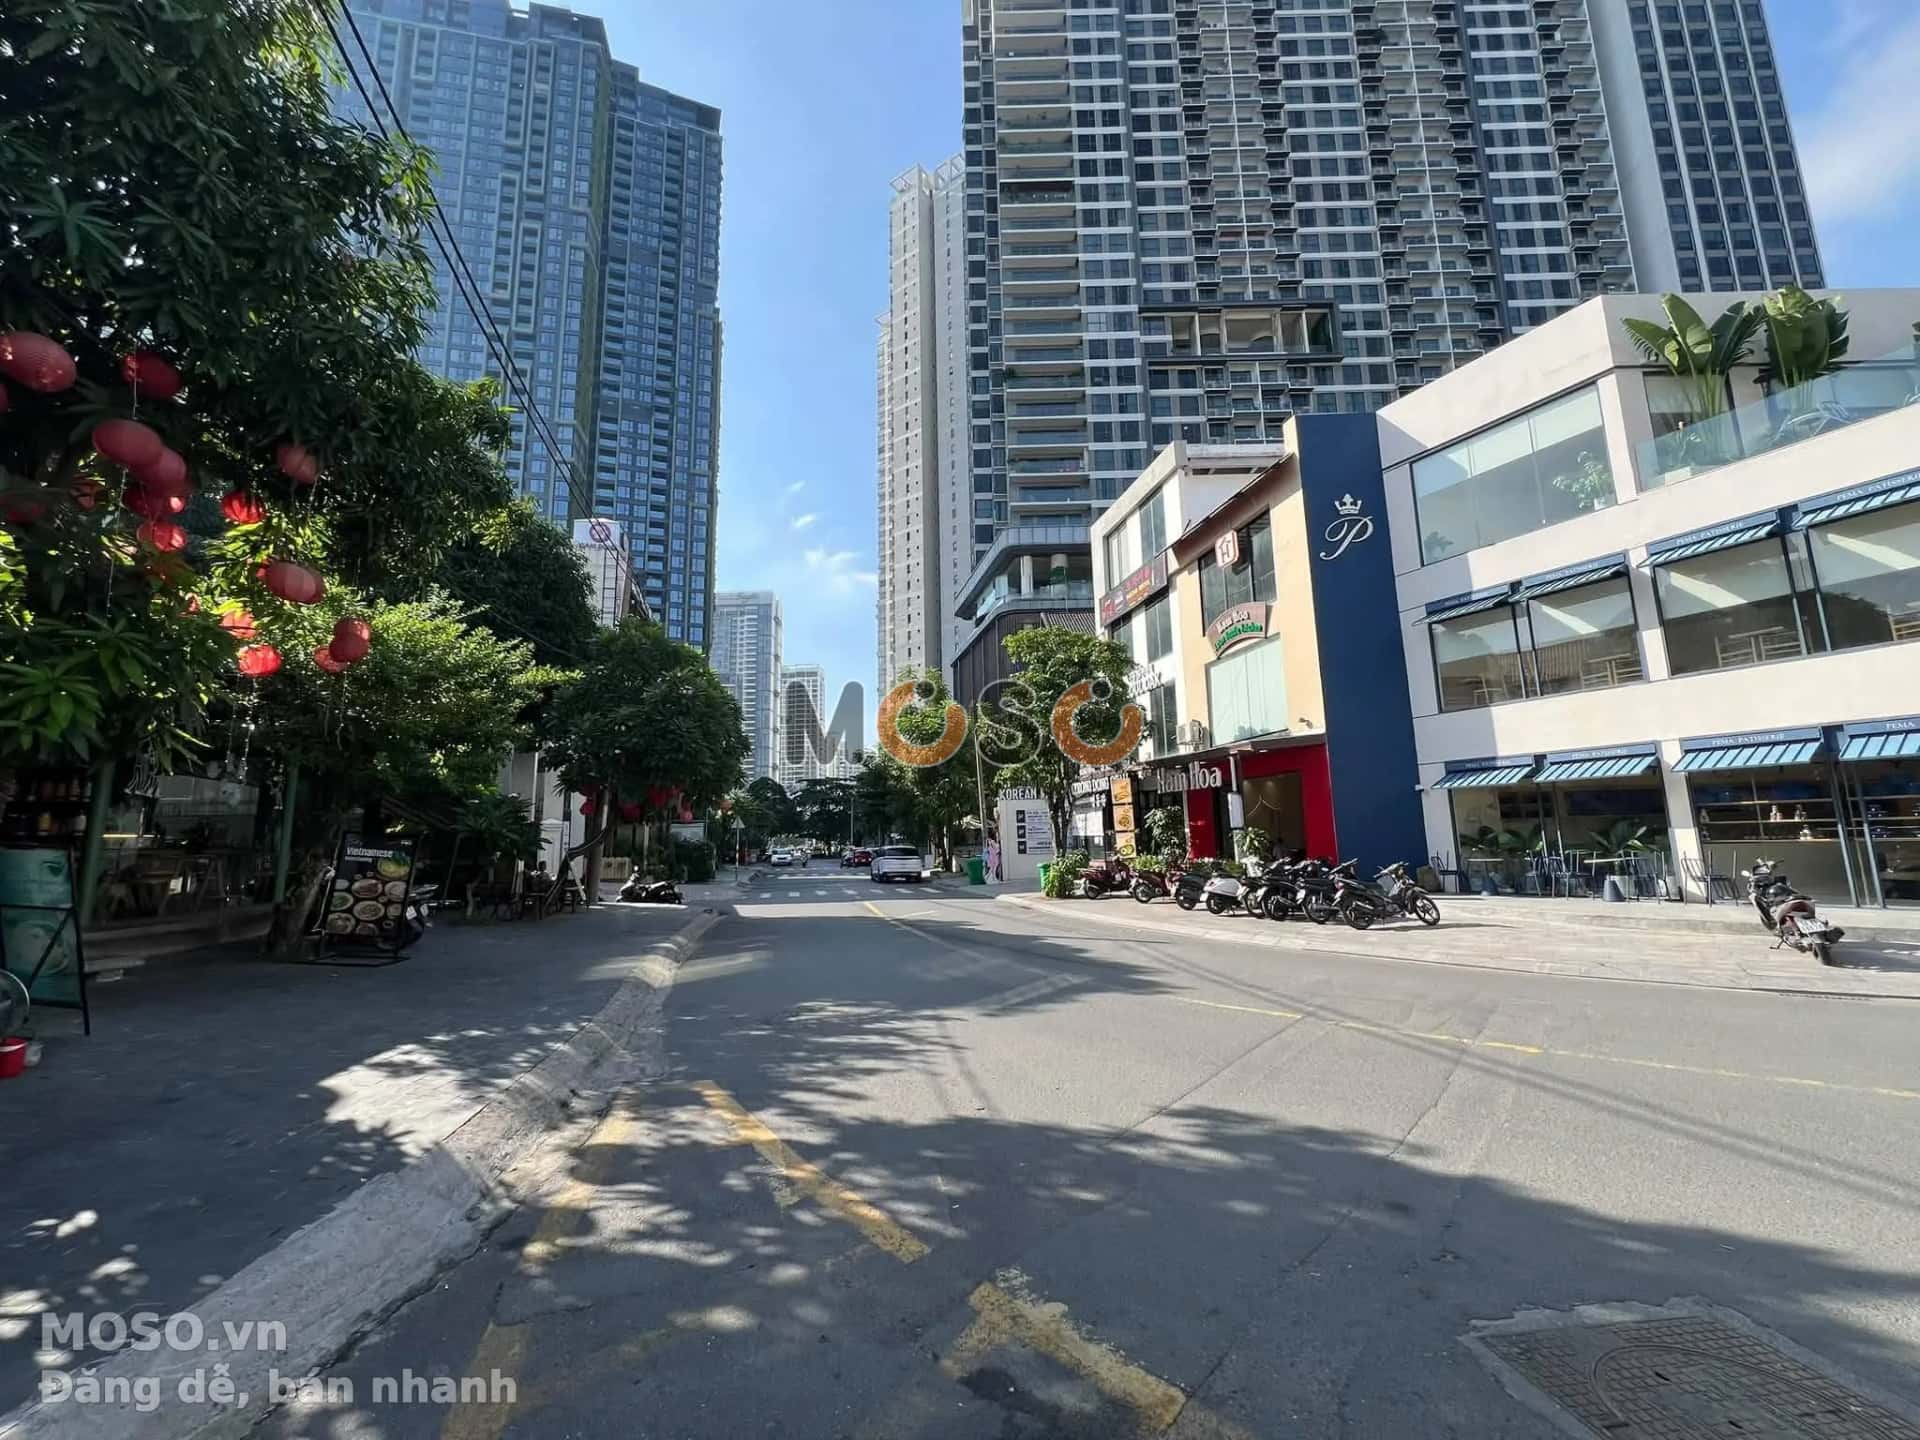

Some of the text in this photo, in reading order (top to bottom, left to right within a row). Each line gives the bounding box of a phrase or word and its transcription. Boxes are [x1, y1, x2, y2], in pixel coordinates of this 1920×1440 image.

[1189, 761, 1222, 790] Hoa
[999, 787, 1037, 801] KOREAN
[346, 847, 394, 858] Vietnamese
